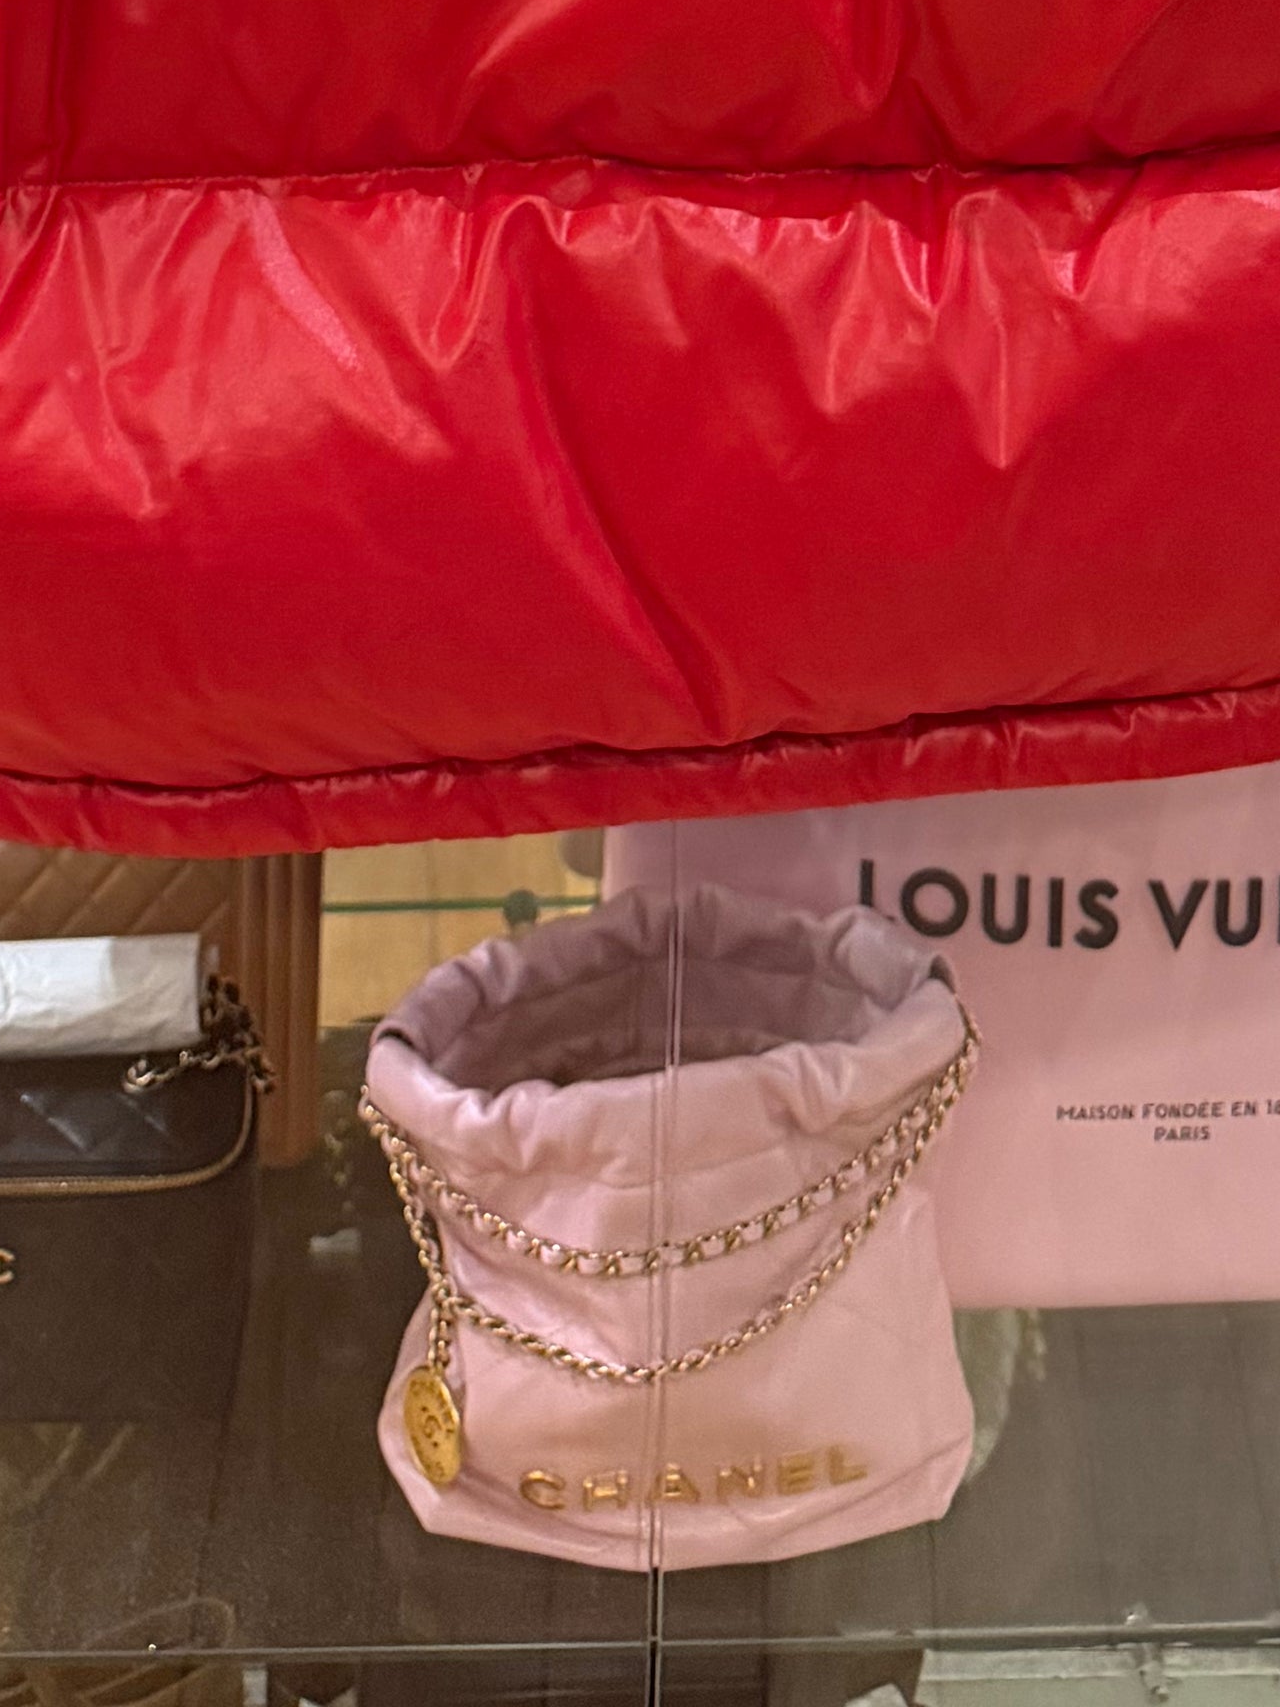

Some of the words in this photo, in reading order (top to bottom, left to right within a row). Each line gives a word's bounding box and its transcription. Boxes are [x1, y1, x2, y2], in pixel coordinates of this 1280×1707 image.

[1056, 1105, 1133, 1120] MAISON
[1231, 1101, 1256, 1116] EN
[1154, 1126, 1210, 1141] PARIS
[520, 1444, 868, 1513] CHANEL
